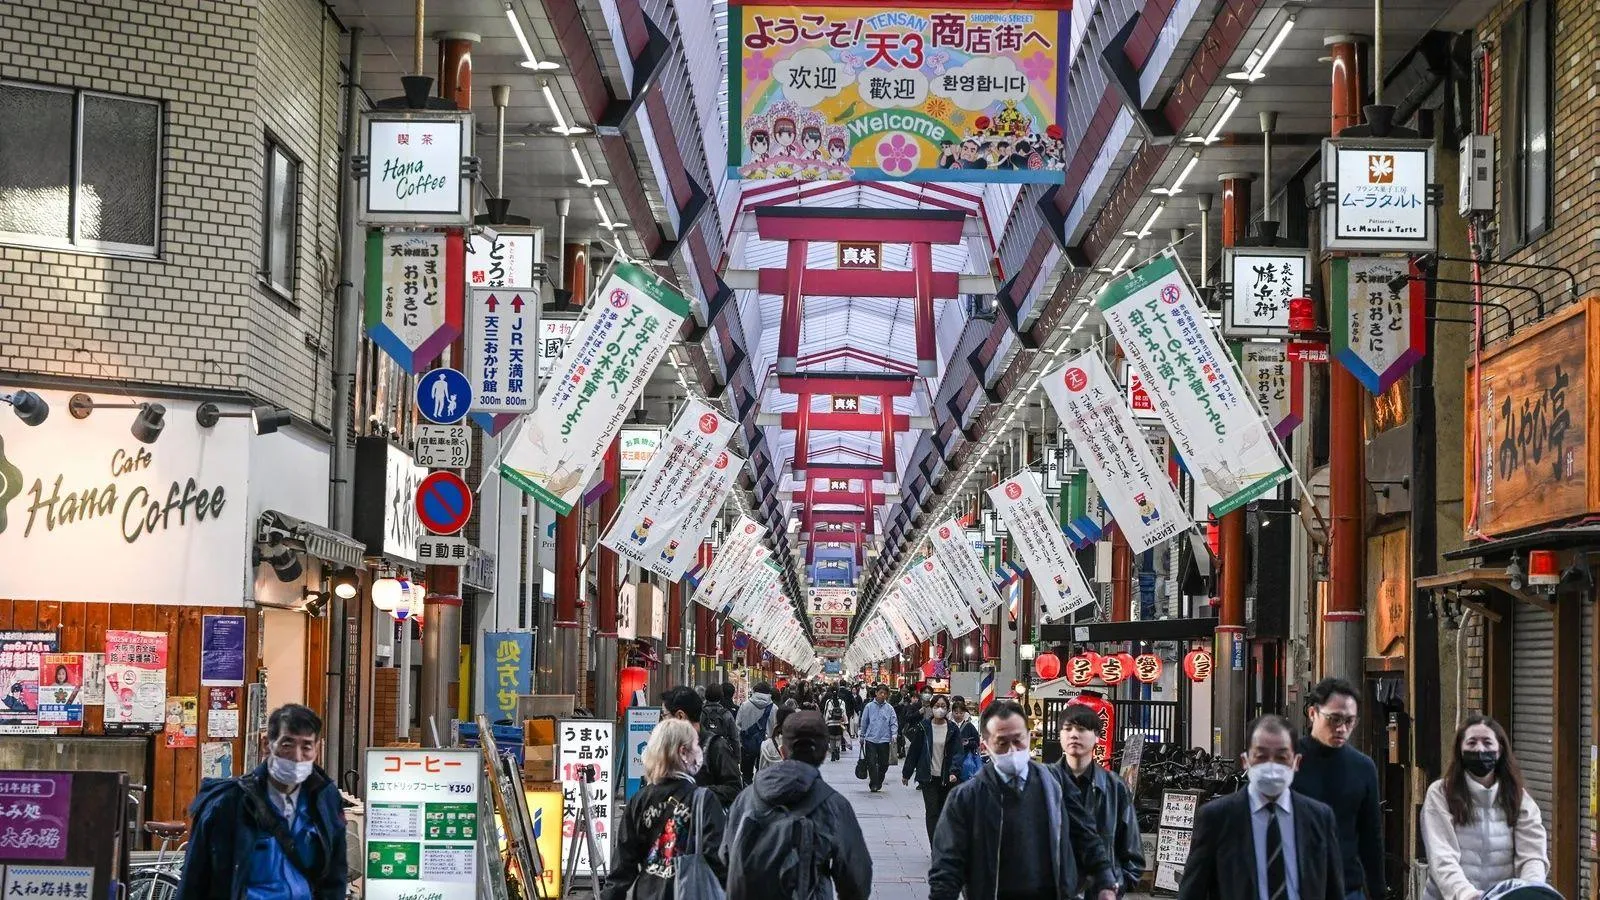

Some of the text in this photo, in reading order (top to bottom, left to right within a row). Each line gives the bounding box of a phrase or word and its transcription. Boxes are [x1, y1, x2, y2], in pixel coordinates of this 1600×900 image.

[867, 12, 928, 32] TENSAN
[970, 14, 1033, 23] SHOPPING STREET
[744, 12, 1051, 69] ようこそ! 天3 商店街へ
[789, 66, 836, 90] 欢迎
[943, 75, 1026, 93] 환영합니다
[870, 78, 915, 100] 歡迎
[848, 112, 946, 141] Welcome
[398, 134, 434, 146] 喫茶
[383, 157, 424, 182] Hana
[396, 174, 446, 200] Coffee
[1342, 193, 1422, 208] ムーラタルト
[842, 248, 876, 264] 真朱
[423, 260, 438, 306] まいど
[403, 265, 418, 326] おおきに
[546, 323, 572, 334] 刃物
[1368, 292, 1384, 352] おおきに
[480, 316, 501, 405] 天三おかげ館 300m
[506, 317, 526, 406] JR天満駅 800m
[602, 313, 661, 400] 住みよい街へ。
[1288, 350, 1327, 360] 一斉開放
[554, 303, 644, 444] マナーの木を育てよう。
[1274, 364, 1284, 400] まいど
[834, 398, 856, 410] 真朱
[1500, 364, 1570, 482] みやび亭
[420, 438, 465, 446] 自転車を除く
[112, 446, 152, 478] Cafe
[24, 473, 118, 538] Hana
[122, 476, 226, 544] Coffee
[420, 542, 466, 558] 自動車
[614, 542, 644, 562] TENSAN
[650, 562, 672, 578] ENSAN
[110, 652, 160, 664] 路上喫煙禁止
[1195, 654, 1211, 678] ハラミ
[1074, 658, 1091, 683] ワイン
[1101, 658, 1122, 682] 上ミノ
[564, 728, 608, 742] うまい
[564, 745, 608, 760] 一品が
[384, 756, 462, 772] コーヒー
[449, 784, 472, 794] ¥350
[564, 788, 608, 802] ビル
[0, 827, 60, 848] 大和路
[9, 880, 88, 898] 大和路特製
